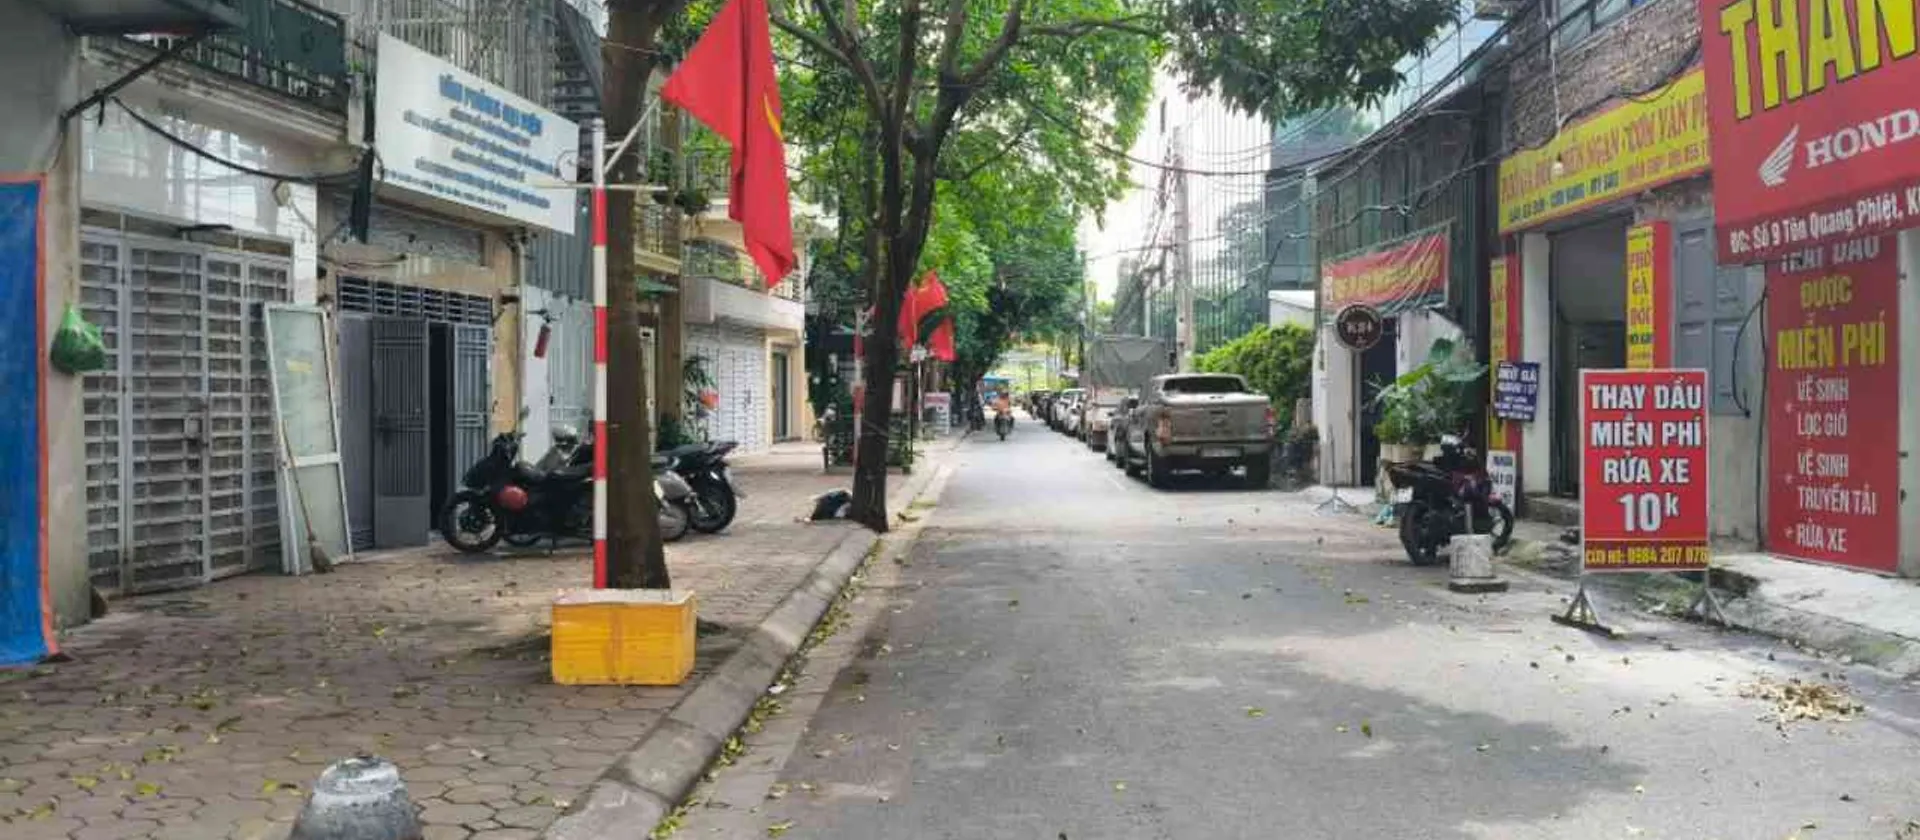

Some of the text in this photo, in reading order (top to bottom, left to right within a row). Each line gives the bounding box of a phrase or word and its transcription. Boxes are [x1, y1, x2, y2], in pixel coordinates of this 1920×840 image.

[1805, 107, 1920, 168] HOND
[1752, 221, 1770, 249] Số
[1771, 222, 1780, 246] 9
[1809, 209, 1854, 240] Quang
[1801, 276, 1853, 311] ĐƯỢC
[1842, 310, 1886, 366] PHÍ
[1589, 384, 1647, 410] THAY
[1816, 377, 1849, 403] SINH
[1661, 416, 1702, 447] PHÍ
[1798, 408, 1848, 439] LỌC GIÓ
[1659, 458, 1690, 483] XE
[1816, 453, 1849, 478] SINH
[1827, 527, 1849, 553] XE
